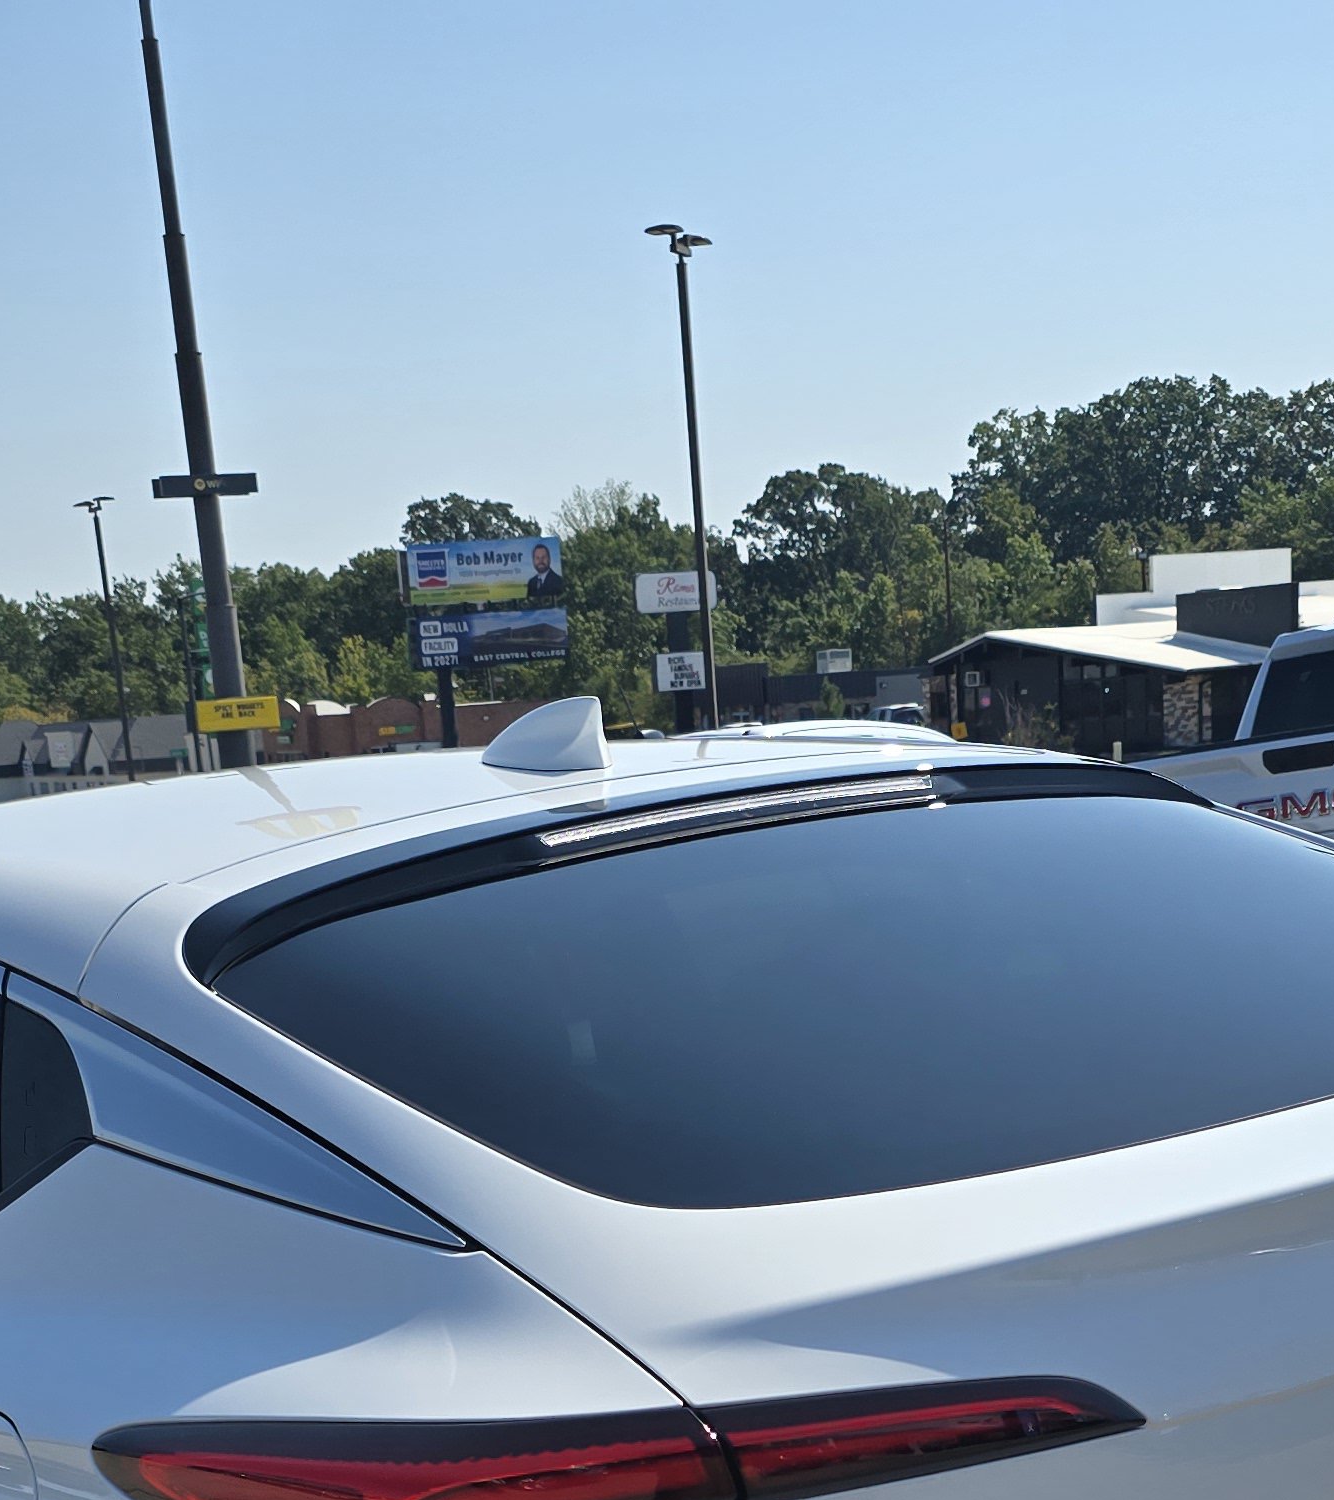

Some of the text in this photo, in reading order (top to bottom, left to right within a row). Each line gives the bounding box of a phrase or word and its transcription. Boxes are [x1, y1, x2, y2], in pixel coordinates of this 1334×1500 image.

[456, 551, 524, 568] Bob Mayer
[422, 624, 440, 635] NEW
[424, 641, 457, 652] FACILITY
[422, 654, 459, 668] IN 2027!
[473, 649, 566, 662] EAST CENTRAL COLLEGE
